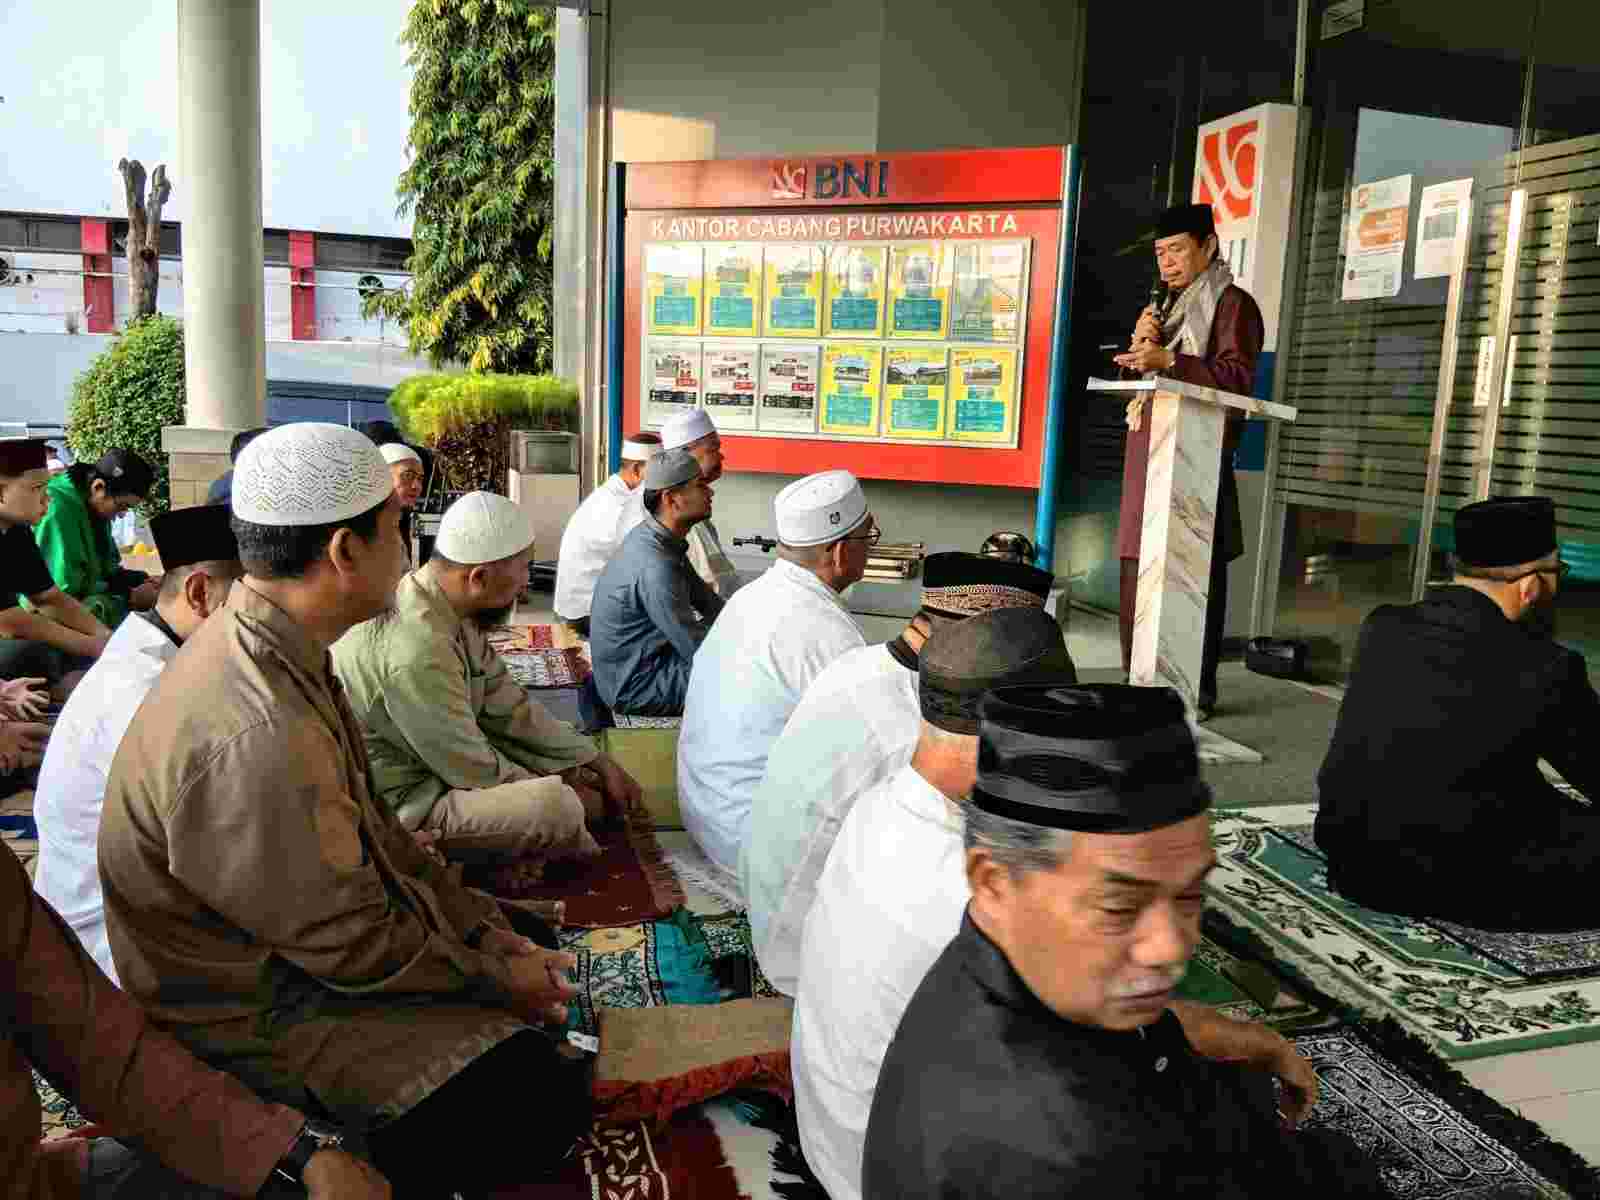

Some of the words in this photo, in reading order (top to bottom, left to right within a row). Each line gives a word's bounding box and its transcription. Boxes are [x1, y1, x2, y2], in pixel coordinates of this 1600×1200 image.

[815, 159, 889, 200] BNI
[651, 216, 740, 239] KANTOR
[746, 215, 842, 238] CABANG
[846, 213, 1019, 237] PURWAKARTA
